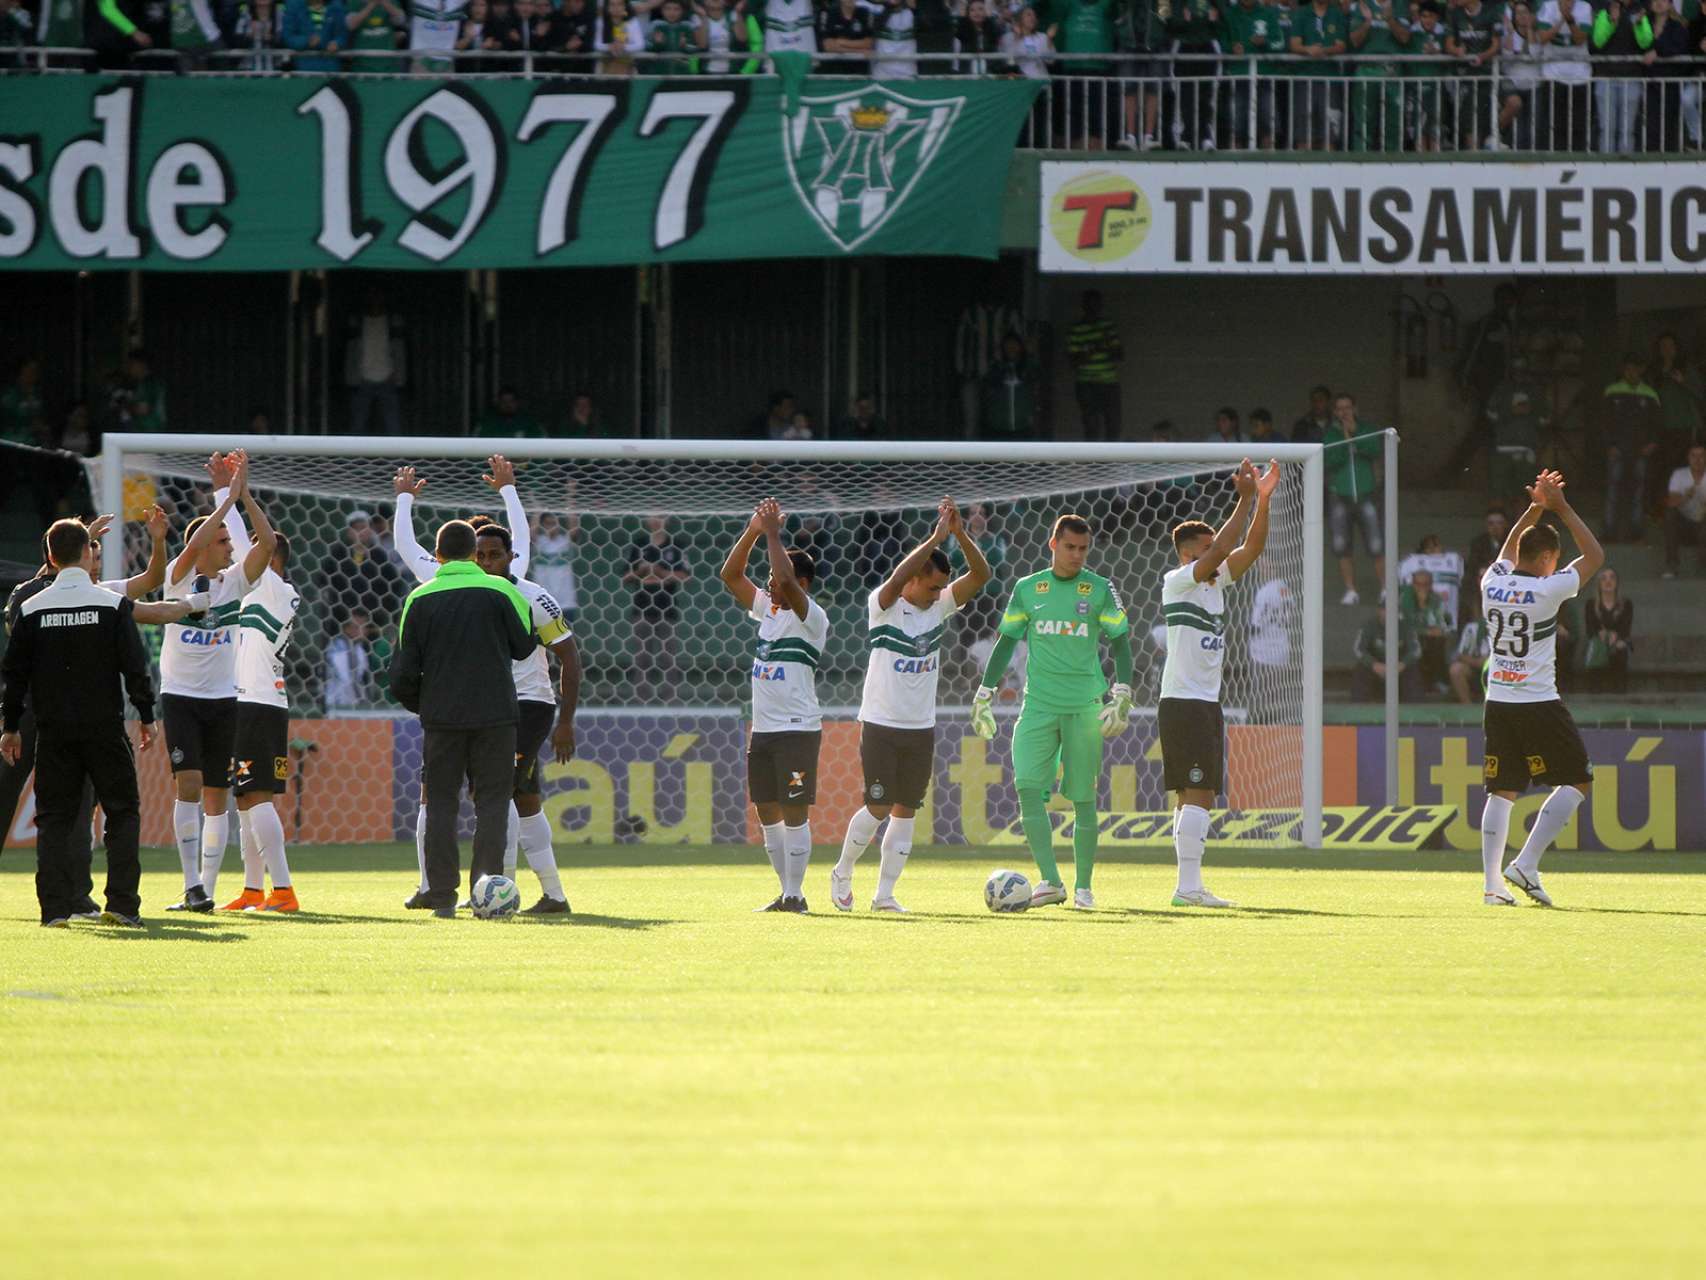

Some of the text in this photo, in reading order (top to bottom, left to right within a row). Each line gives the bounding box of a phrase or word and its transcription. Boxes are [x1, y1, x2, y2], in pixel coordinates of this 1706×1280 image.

[0, 84, 742, 262] sde 1977
[1165, 170, 1706, 264] TRANSAMÉRIC
[1487, 587, 1536, 604] CAIXA
[181, 629, 232, 646] CAIXA
[1036, 620, 1089, 637] CAIXA
[1488, 608, 1529, 657] 23
[1398, 736, 1677, 851] Itaú
